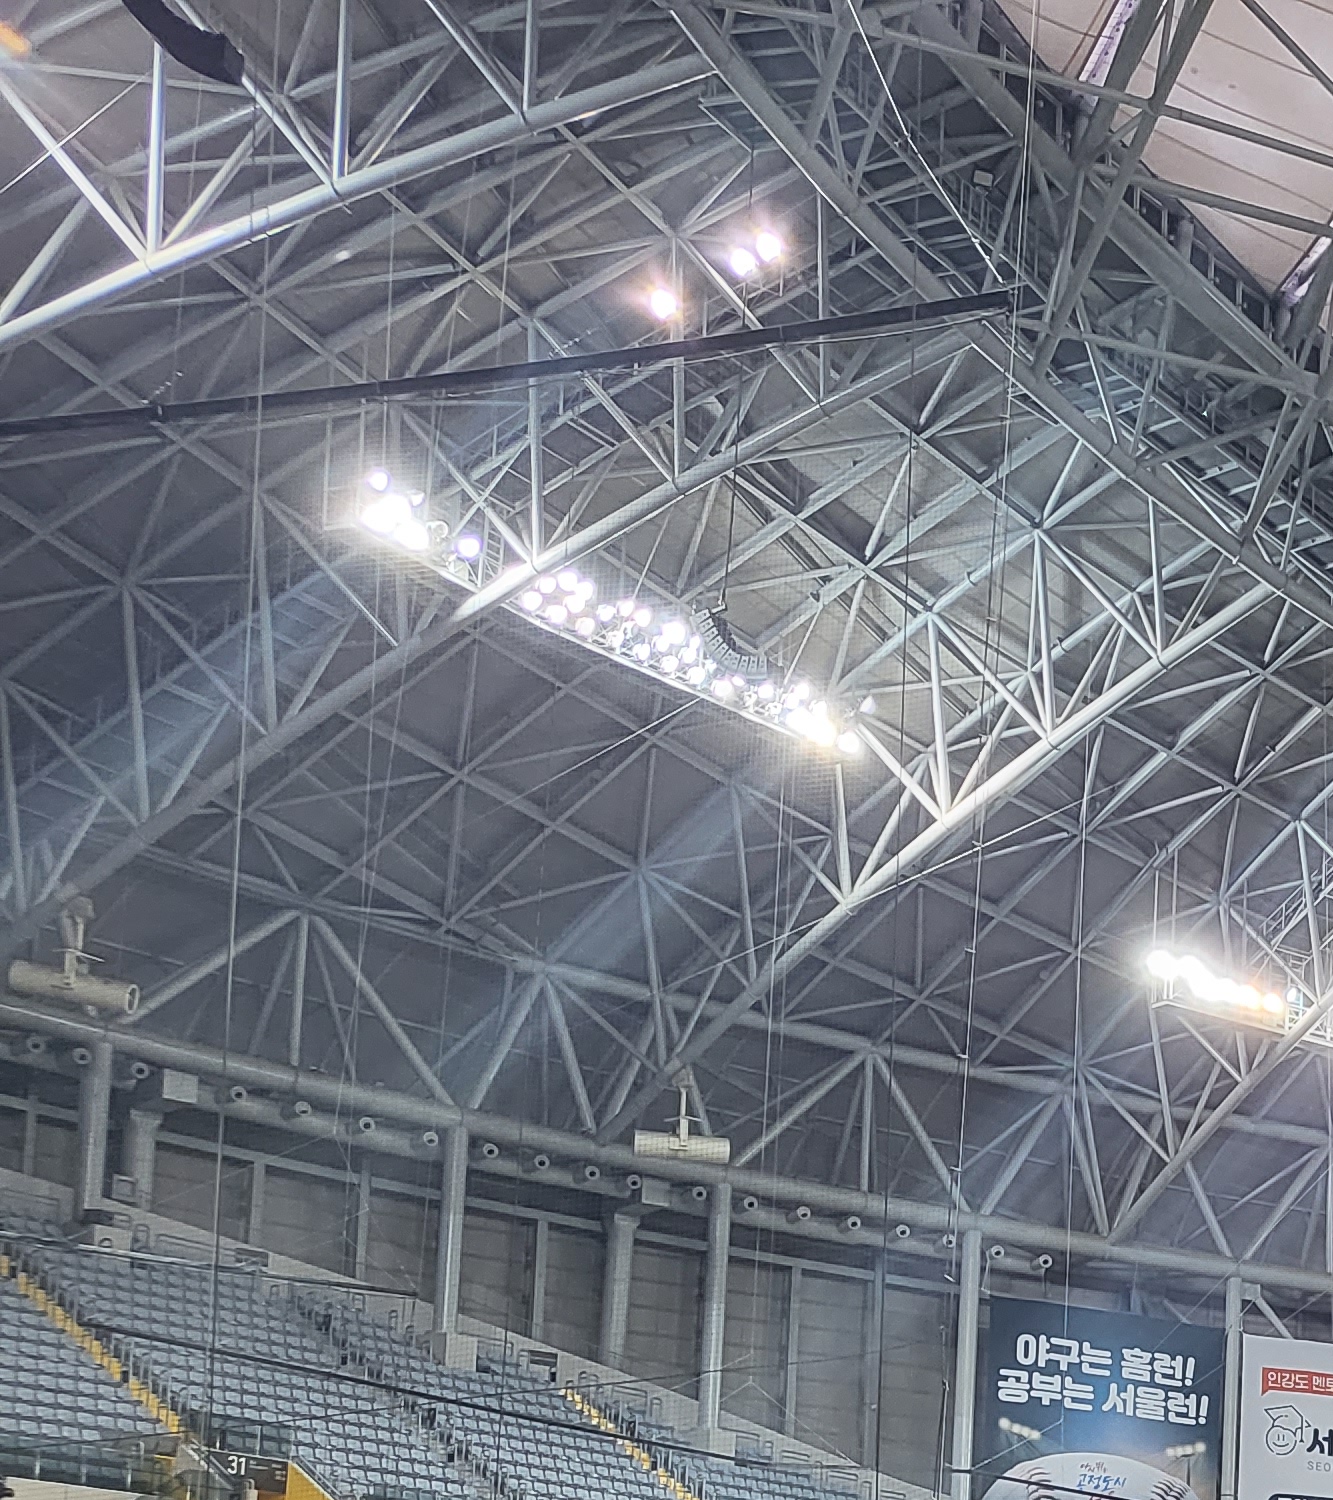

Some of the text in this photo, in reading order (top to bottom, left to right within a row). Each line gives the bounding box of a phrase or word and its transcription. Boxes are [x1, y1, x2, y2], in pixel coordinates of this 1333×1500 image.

[1016, 1334, 1196, 1386] 야구는 홈런!
[997, 1369, 1209, 1425] 공부는 서울런!
[1267, 1371, 1309, 1389] 인강도
[227, 1454, 247, 1476] 31
